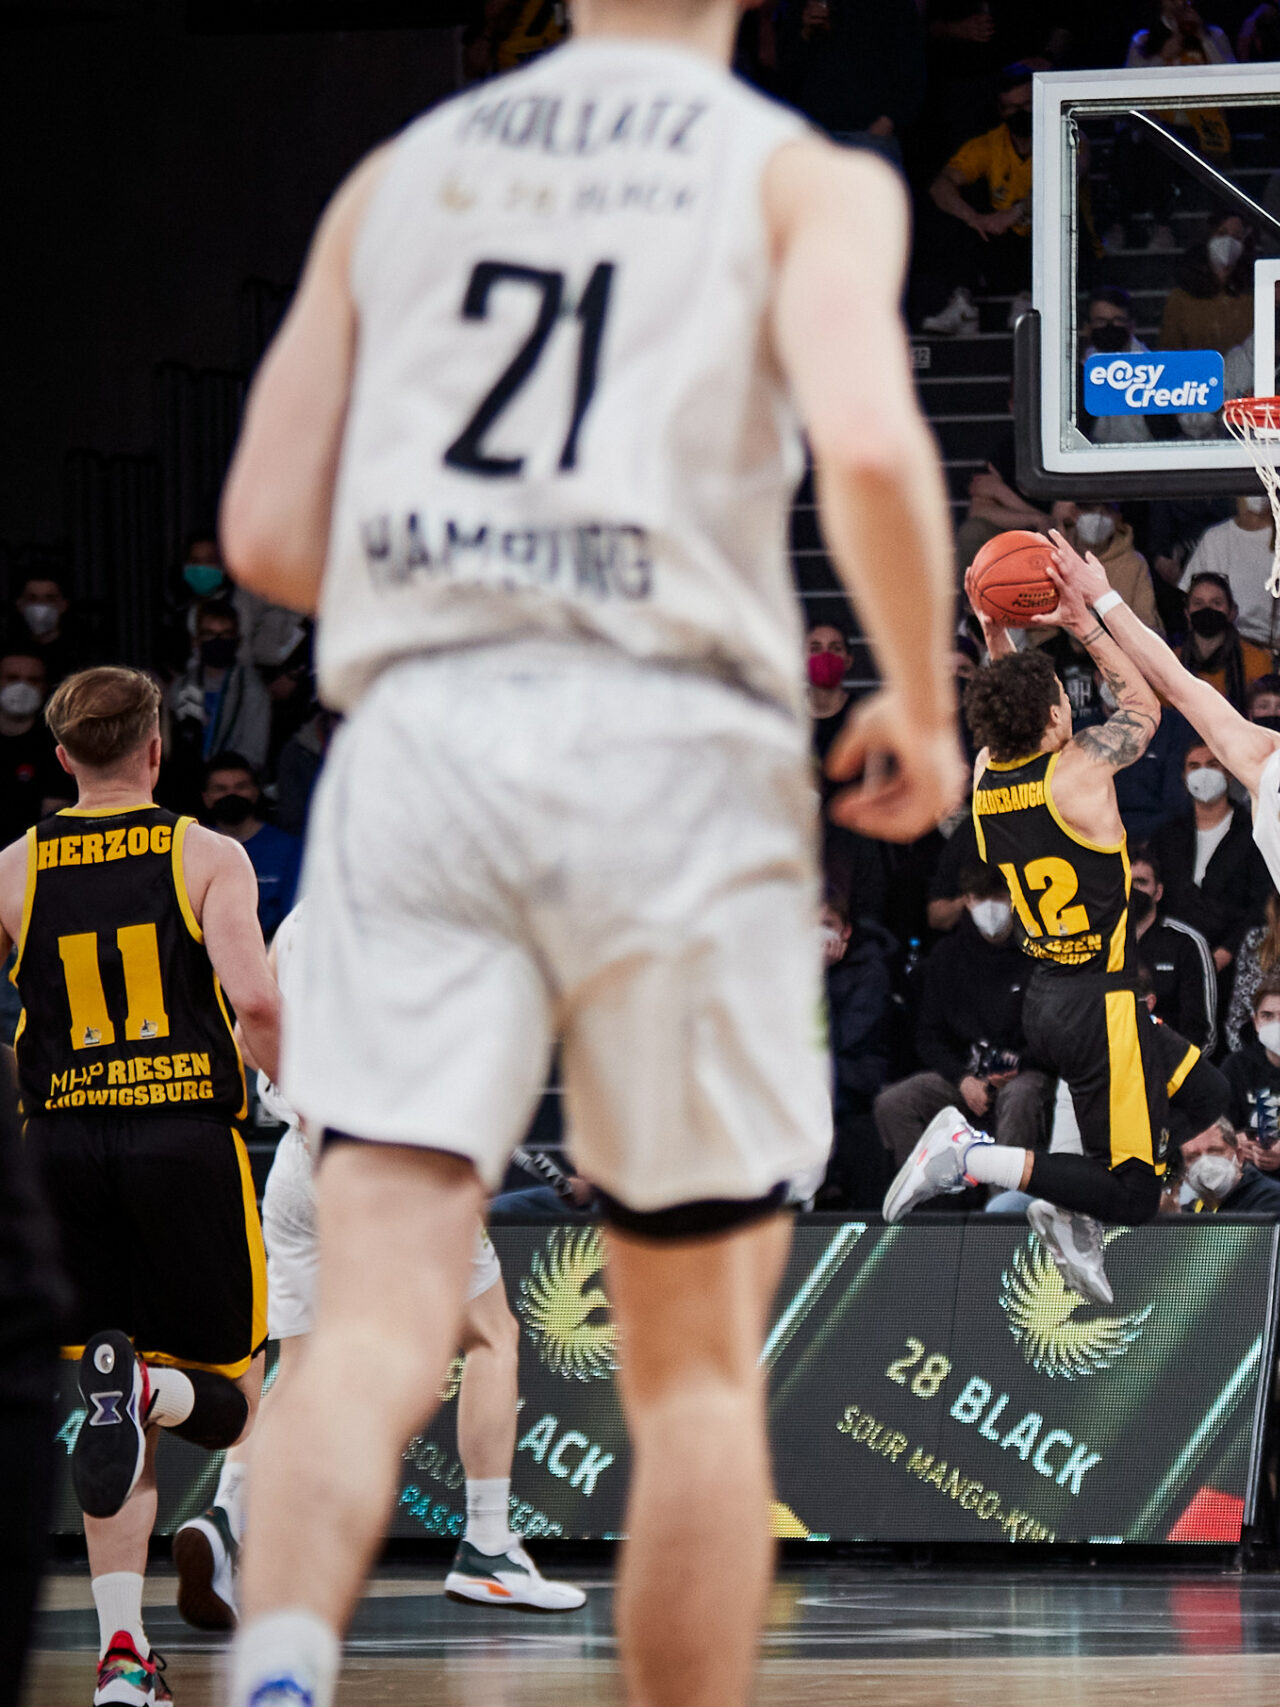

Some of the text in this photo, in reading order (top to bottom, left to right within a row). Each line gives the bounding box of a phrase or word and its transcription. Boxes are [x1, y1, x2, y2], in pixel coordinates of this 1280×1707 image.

[442, 259, 616, 478] 21
[37, 825, 173, 871] HERZOG
[998, 856, 1090, 938] 12
[58, 922, 170, 1050] 11
[107, 1052, 212, 1085] RIESEN
[836, 1404, 908, 1463] SOUR
[884, 1335, 1102, 1497] 28 BLACK
